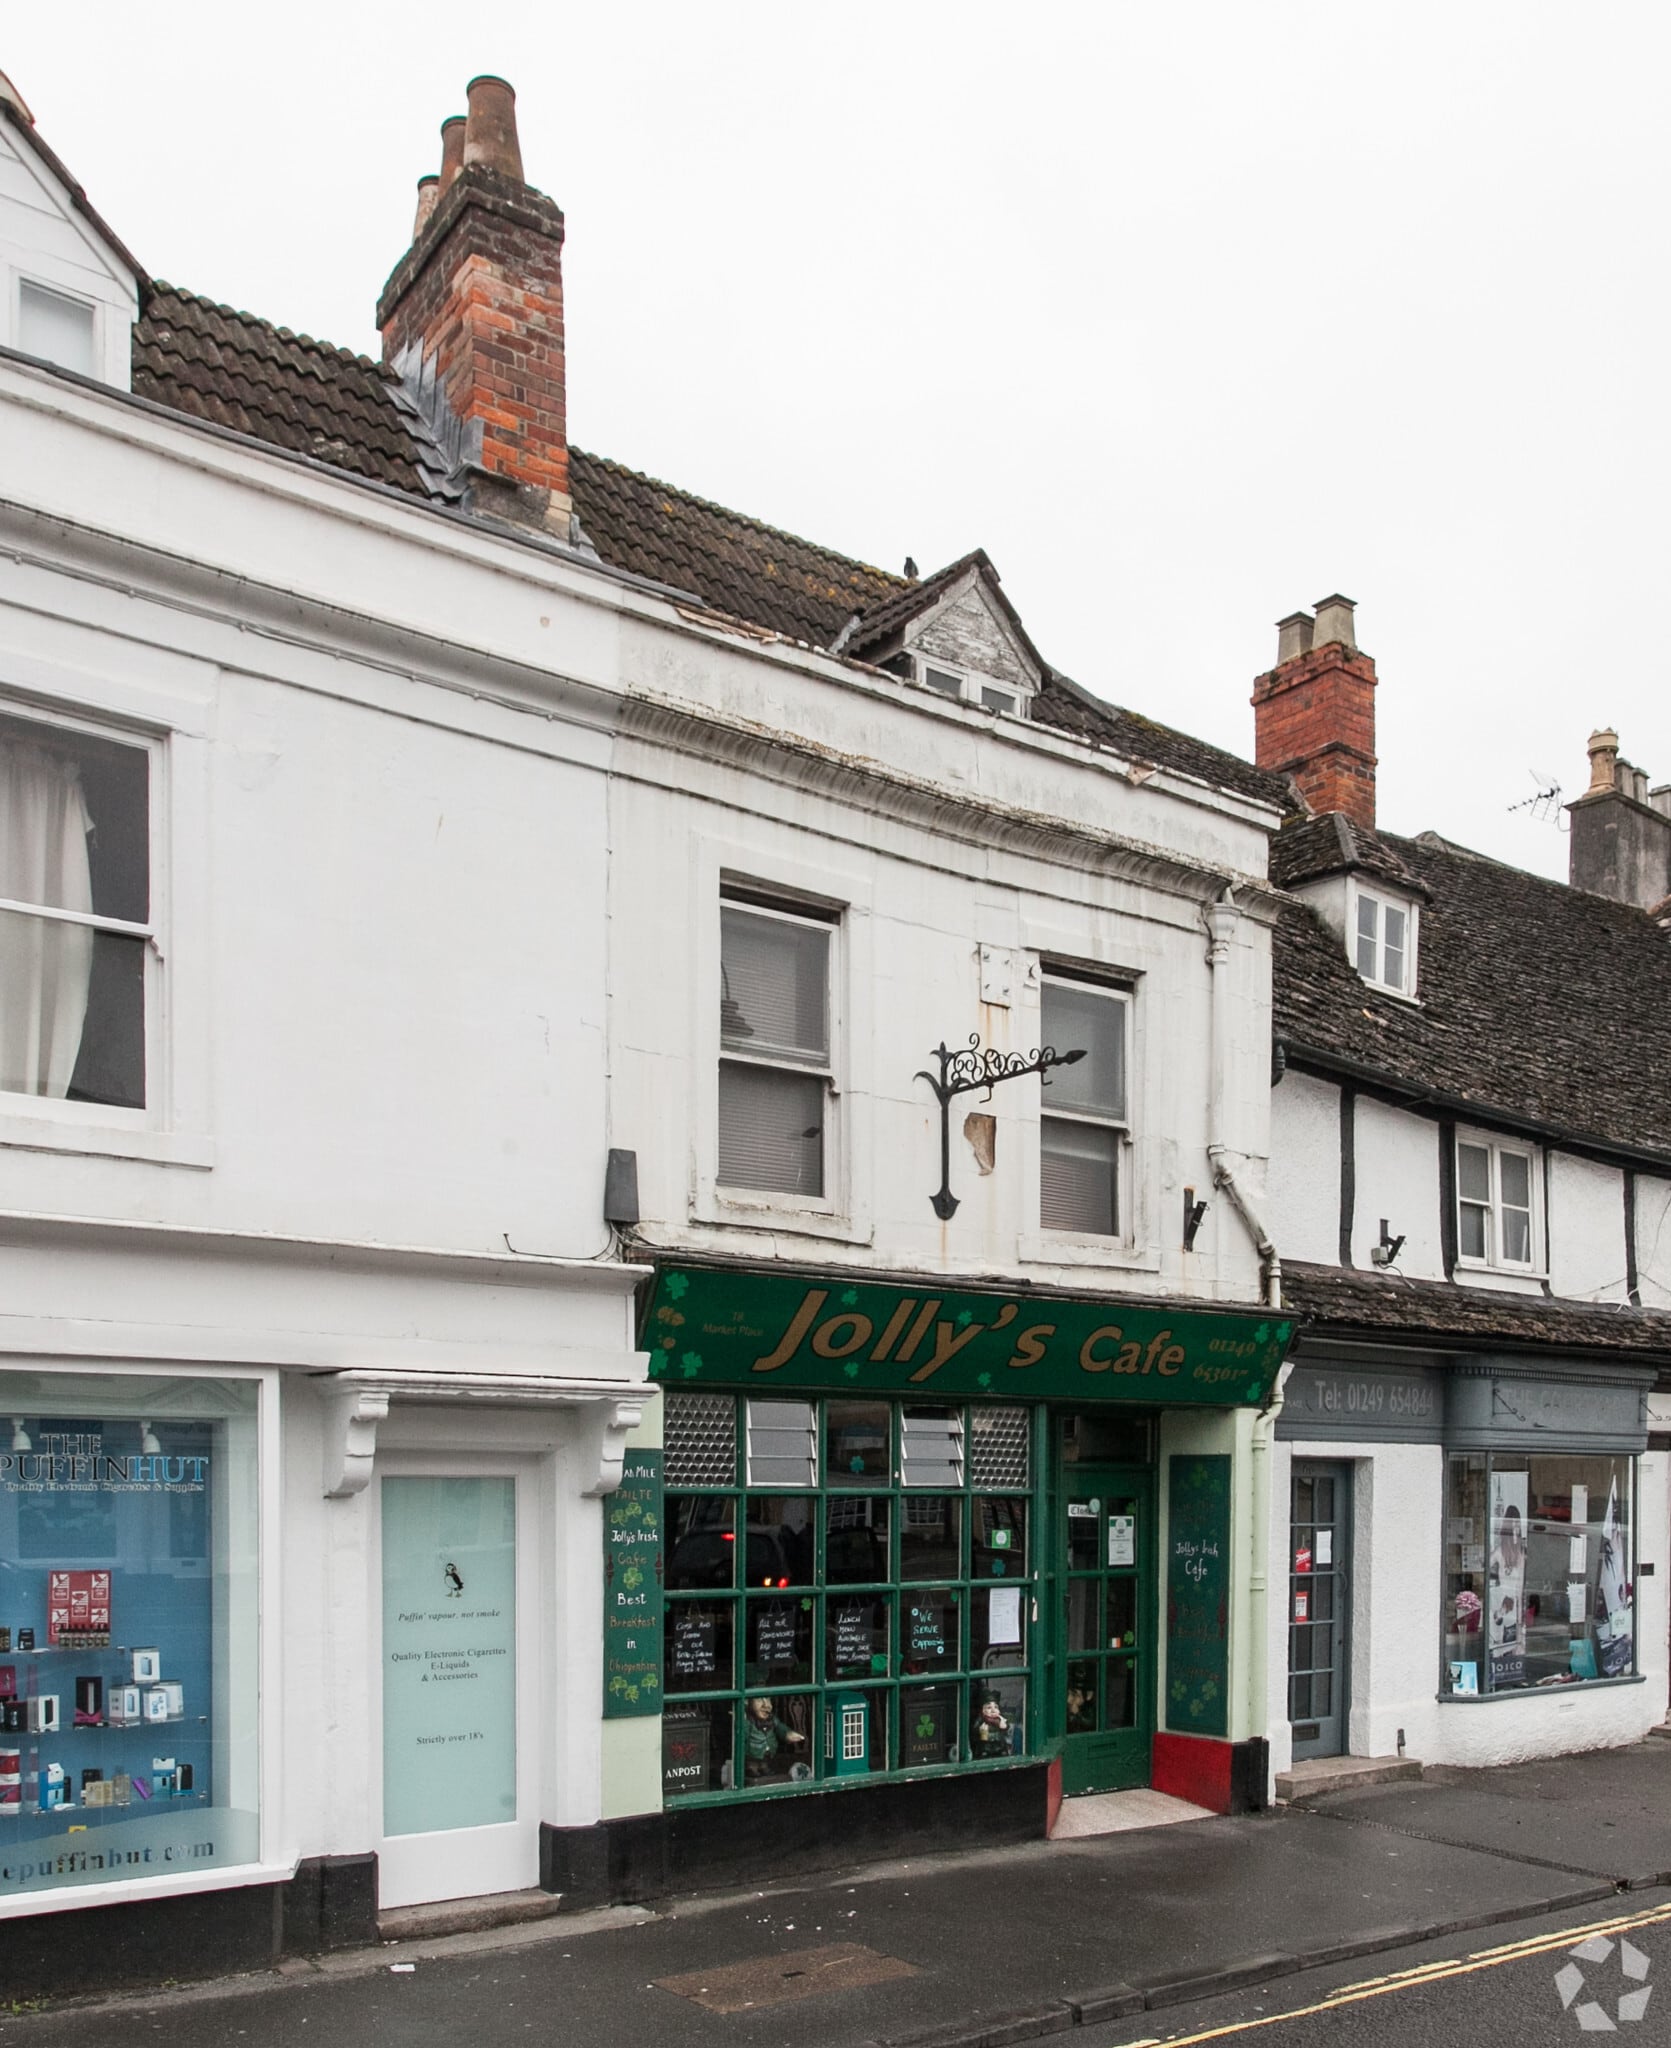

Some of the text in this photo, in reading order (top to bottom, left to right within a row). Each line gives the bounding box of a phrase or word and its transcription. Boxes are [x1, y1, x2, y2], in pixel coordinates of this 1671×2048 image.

[751, 1288, 1185, 1382] Jolly's Cafe
[1314, 1380, 1434, 1415] Tel: 01249 654844
[40, 1433, 102, 1455] THE
[617, 1592, 647, 1605] Best
[461, 1610, 474, 1618] not
[476, 1609, 501, 1618] smoke
[391, 1648, 506, 1662] Quality Electronic Cigarettes
[430, 1660, 470, 1670] E-Liquids
[421, 1672, 479, 1682] & Accessories
[416, 1734, 446, 1745] Strictly
[448, 1734, 467, 1742] over
[665, 1765, 702, 1779] ANPOST
[3, 1841, 214, 1884] epuffinhut.com
